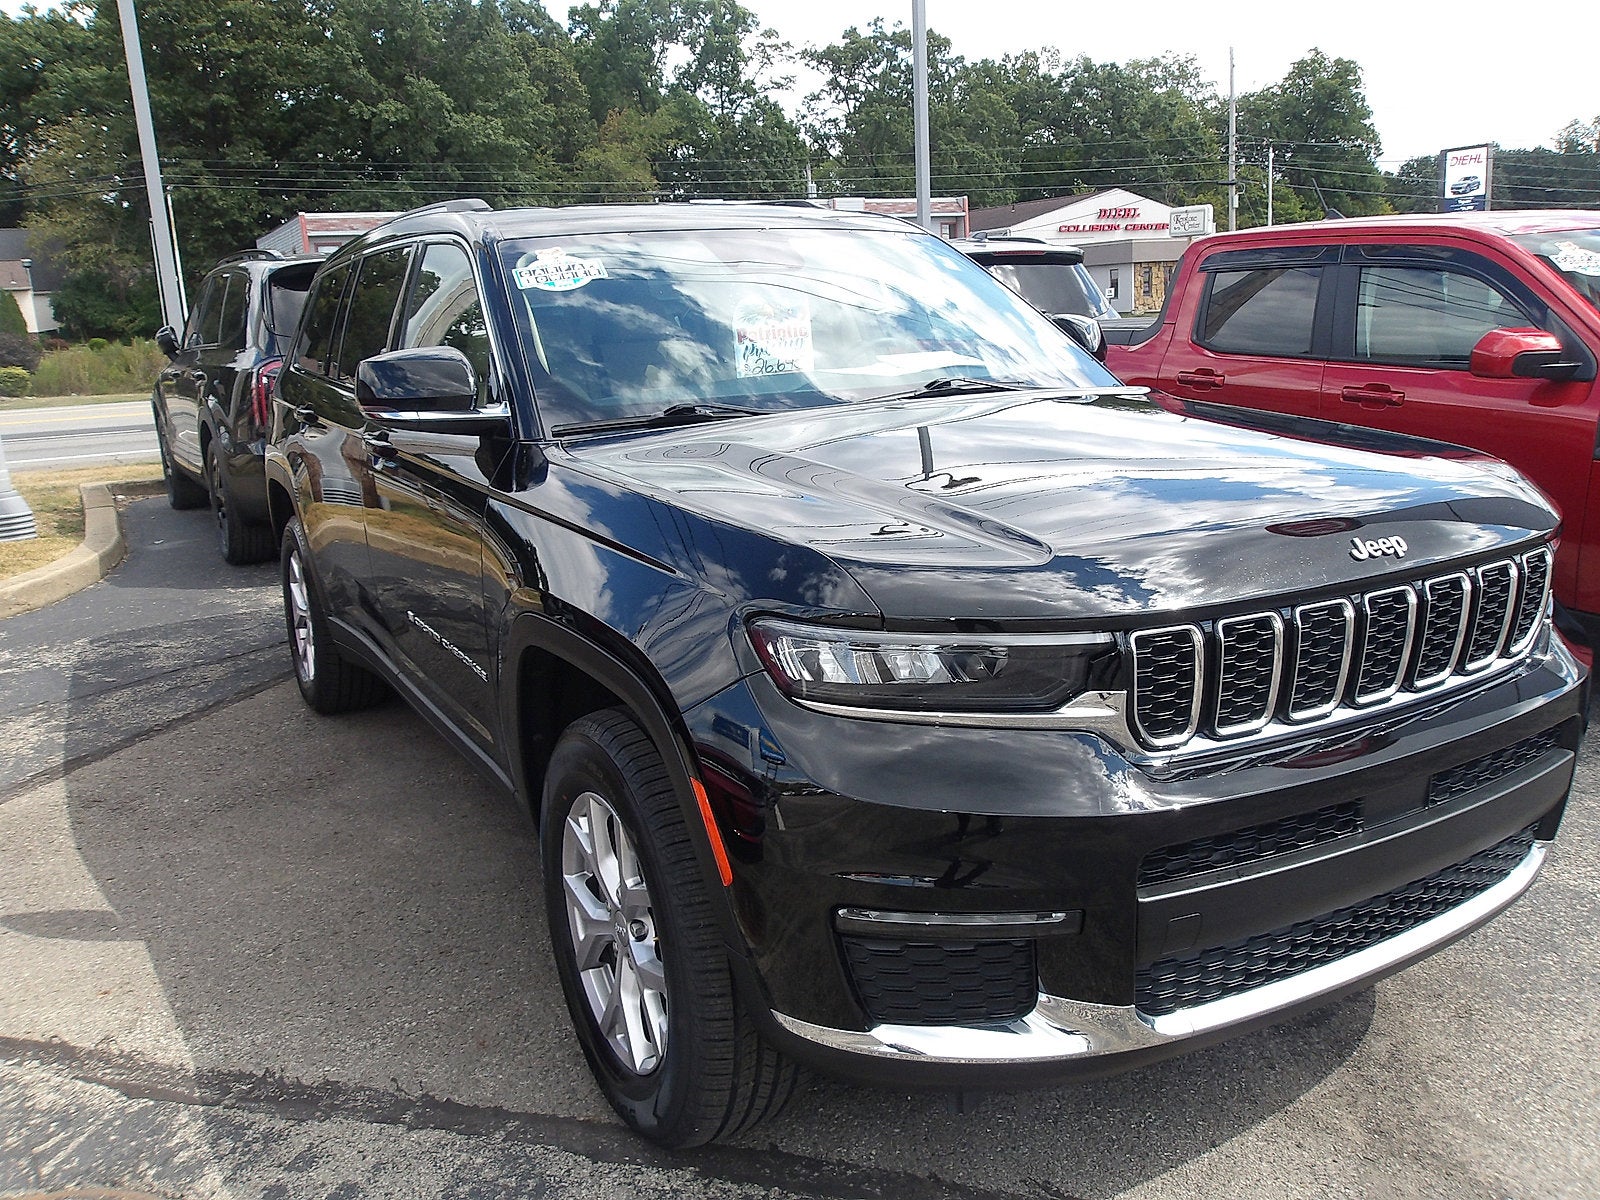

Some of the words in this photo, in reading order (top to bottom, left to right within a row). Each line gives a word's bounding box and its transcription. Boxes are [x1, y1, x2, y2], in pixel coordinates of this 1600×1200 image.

[1450, 153, 1483, 167] DIEHL
[1097, 207, 1140, 220] DIEHL
[1058, 223, 1121, 233] COLLISION
[1124, 222, 1170, 232] CENTER
[1350, 534, 1408, 561] Jeep
